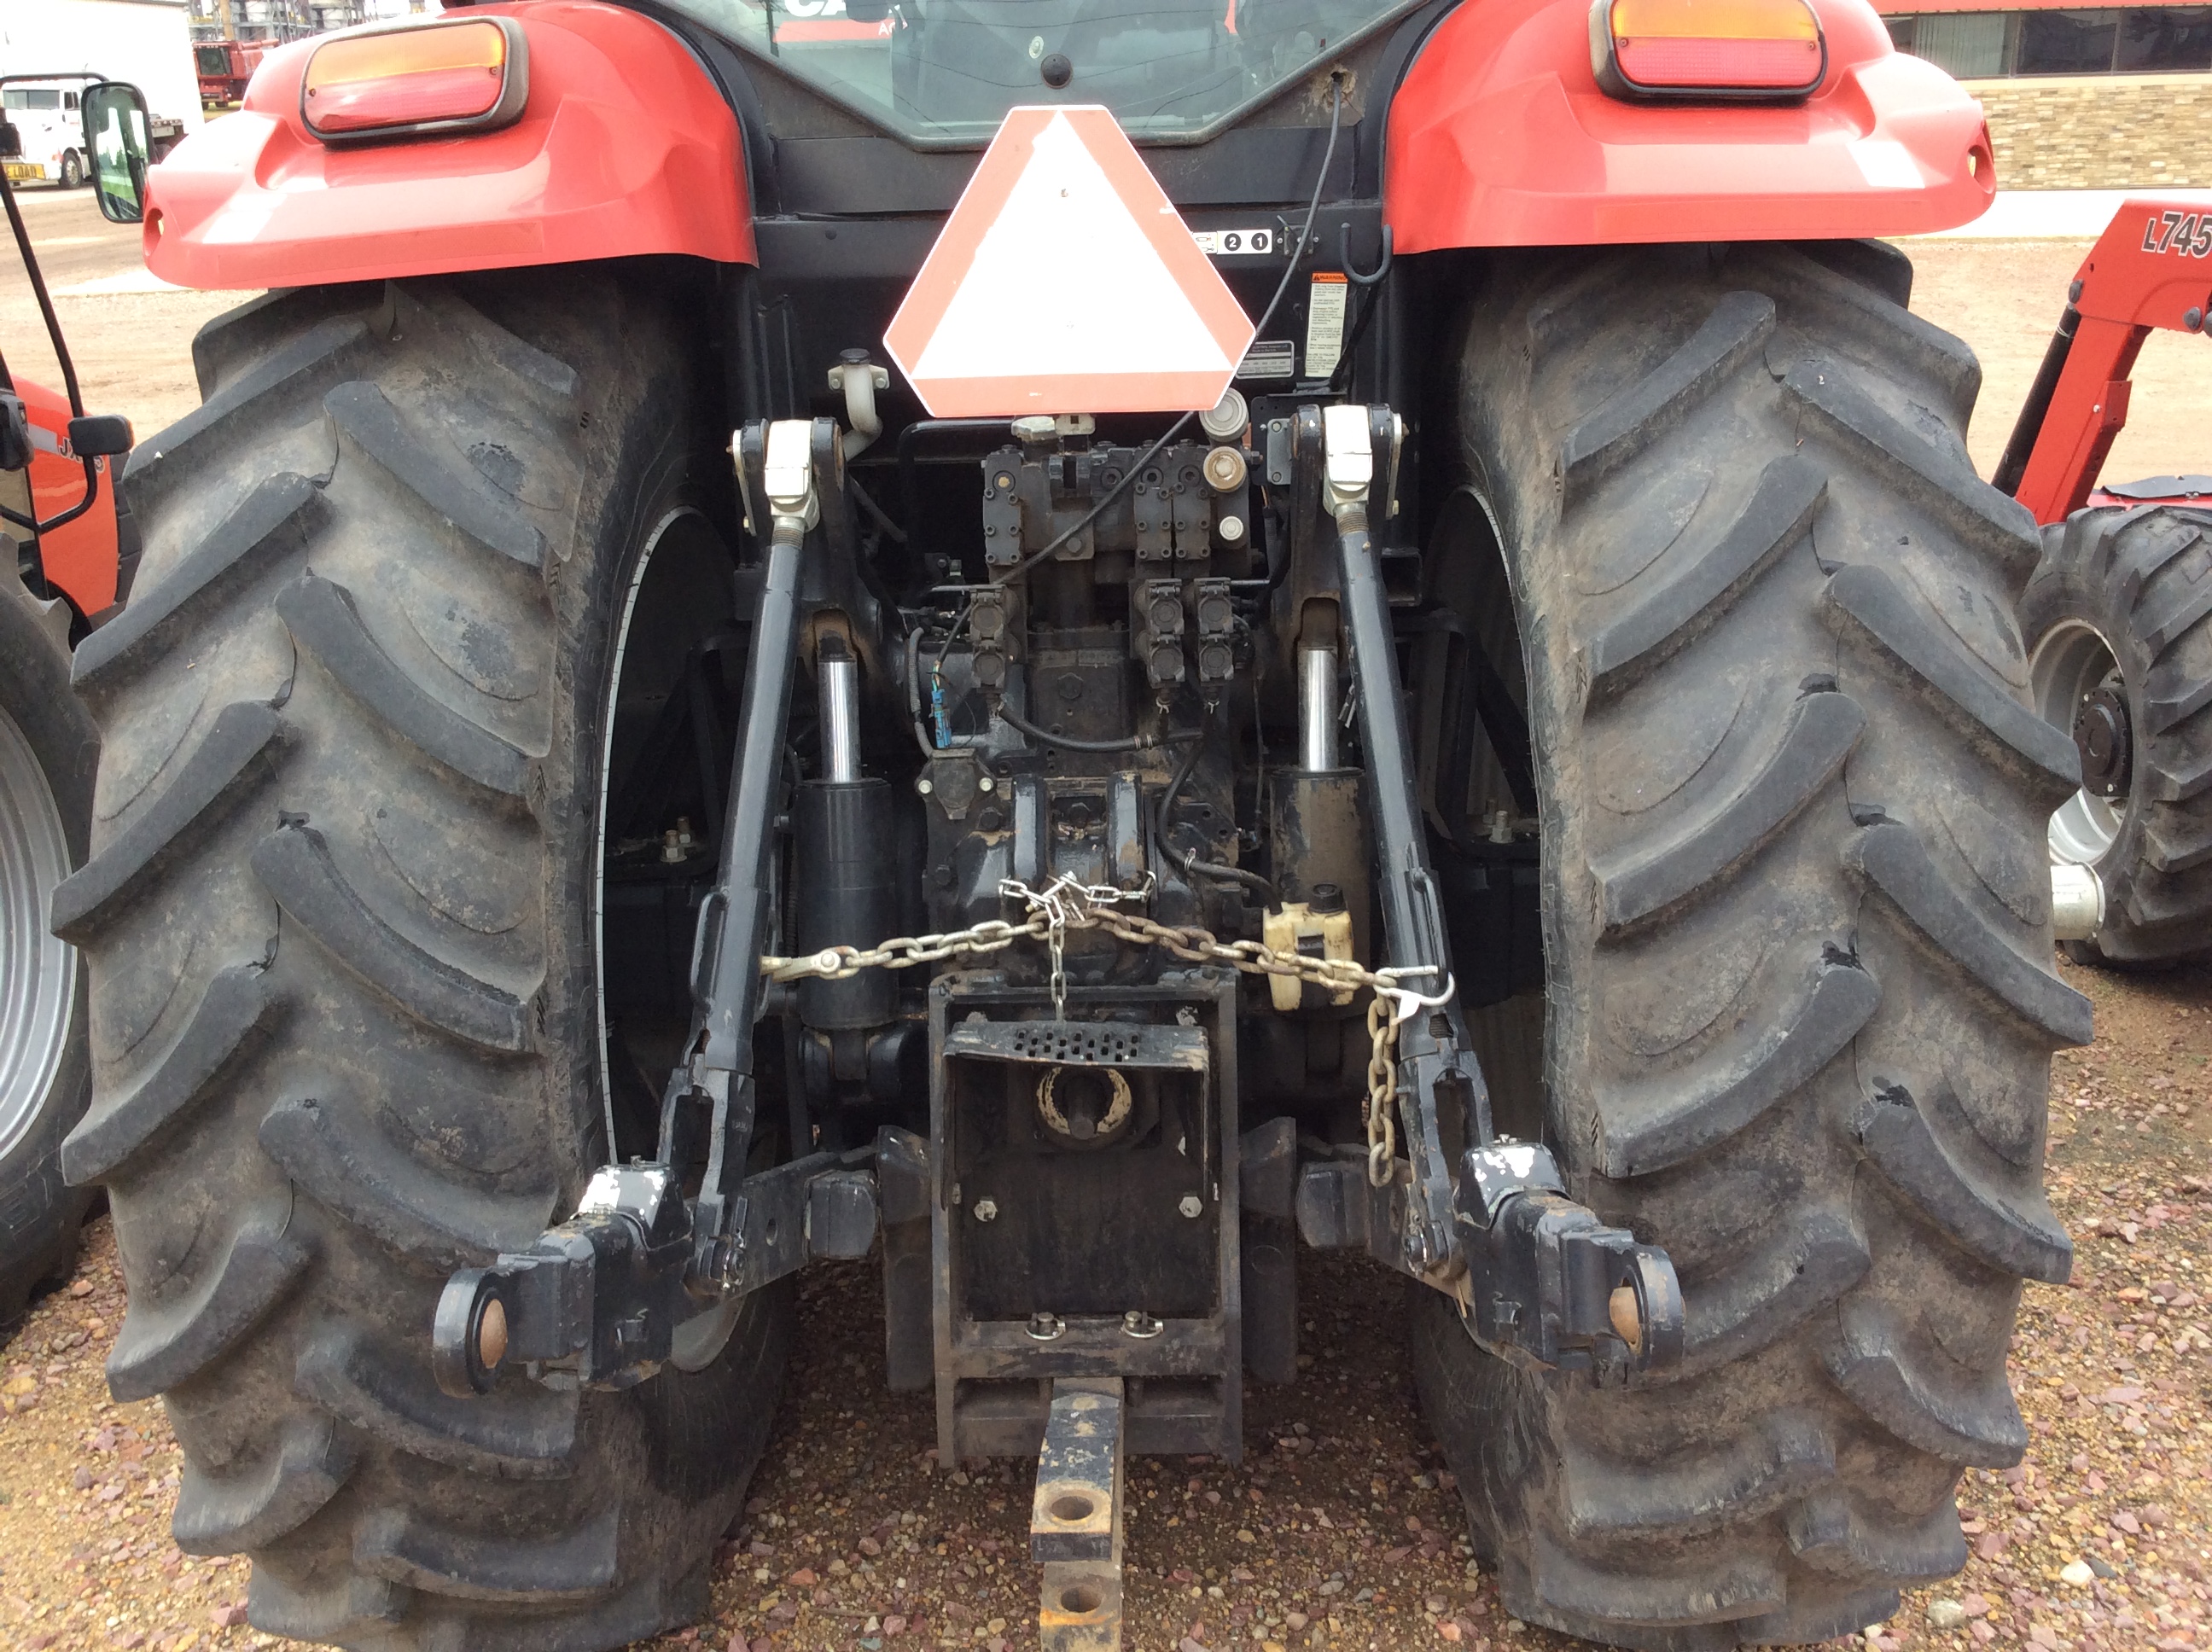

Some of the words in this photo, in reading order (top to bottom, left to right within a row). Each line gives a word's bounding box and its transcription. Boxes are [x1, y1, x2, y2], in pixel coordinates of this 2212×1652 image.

[14, 166, 38, 178] LOAD
[2141, 211, 2212, 259] L745
[1229, 236, 1237, 248] 2
